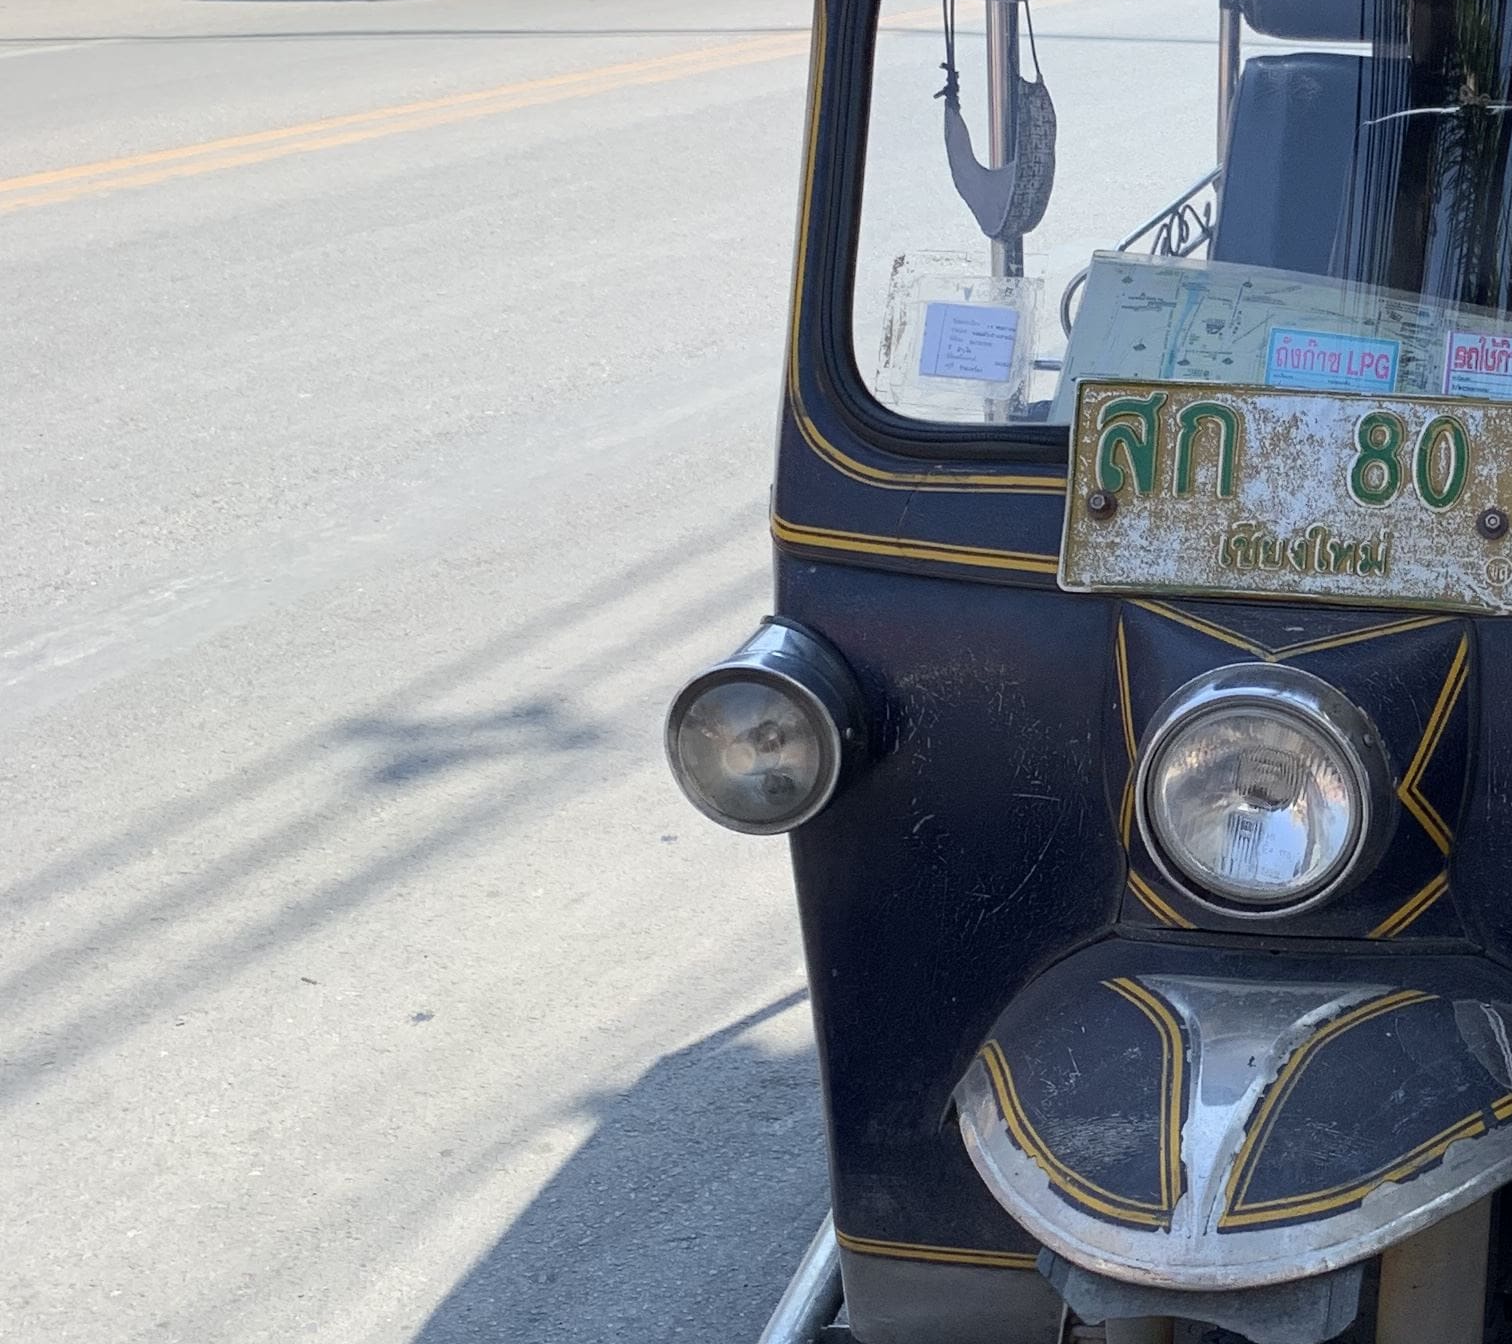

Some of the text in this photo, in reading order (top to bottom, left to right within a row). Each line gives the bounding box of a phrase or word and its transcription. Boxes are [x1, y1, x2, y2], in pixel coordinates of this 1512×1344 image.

[1346, 349, 1391, 380] LPG
[1096, 391, 1472, 514] สก 80
[1216, 518, 1392, 578] เชียงใหม่
